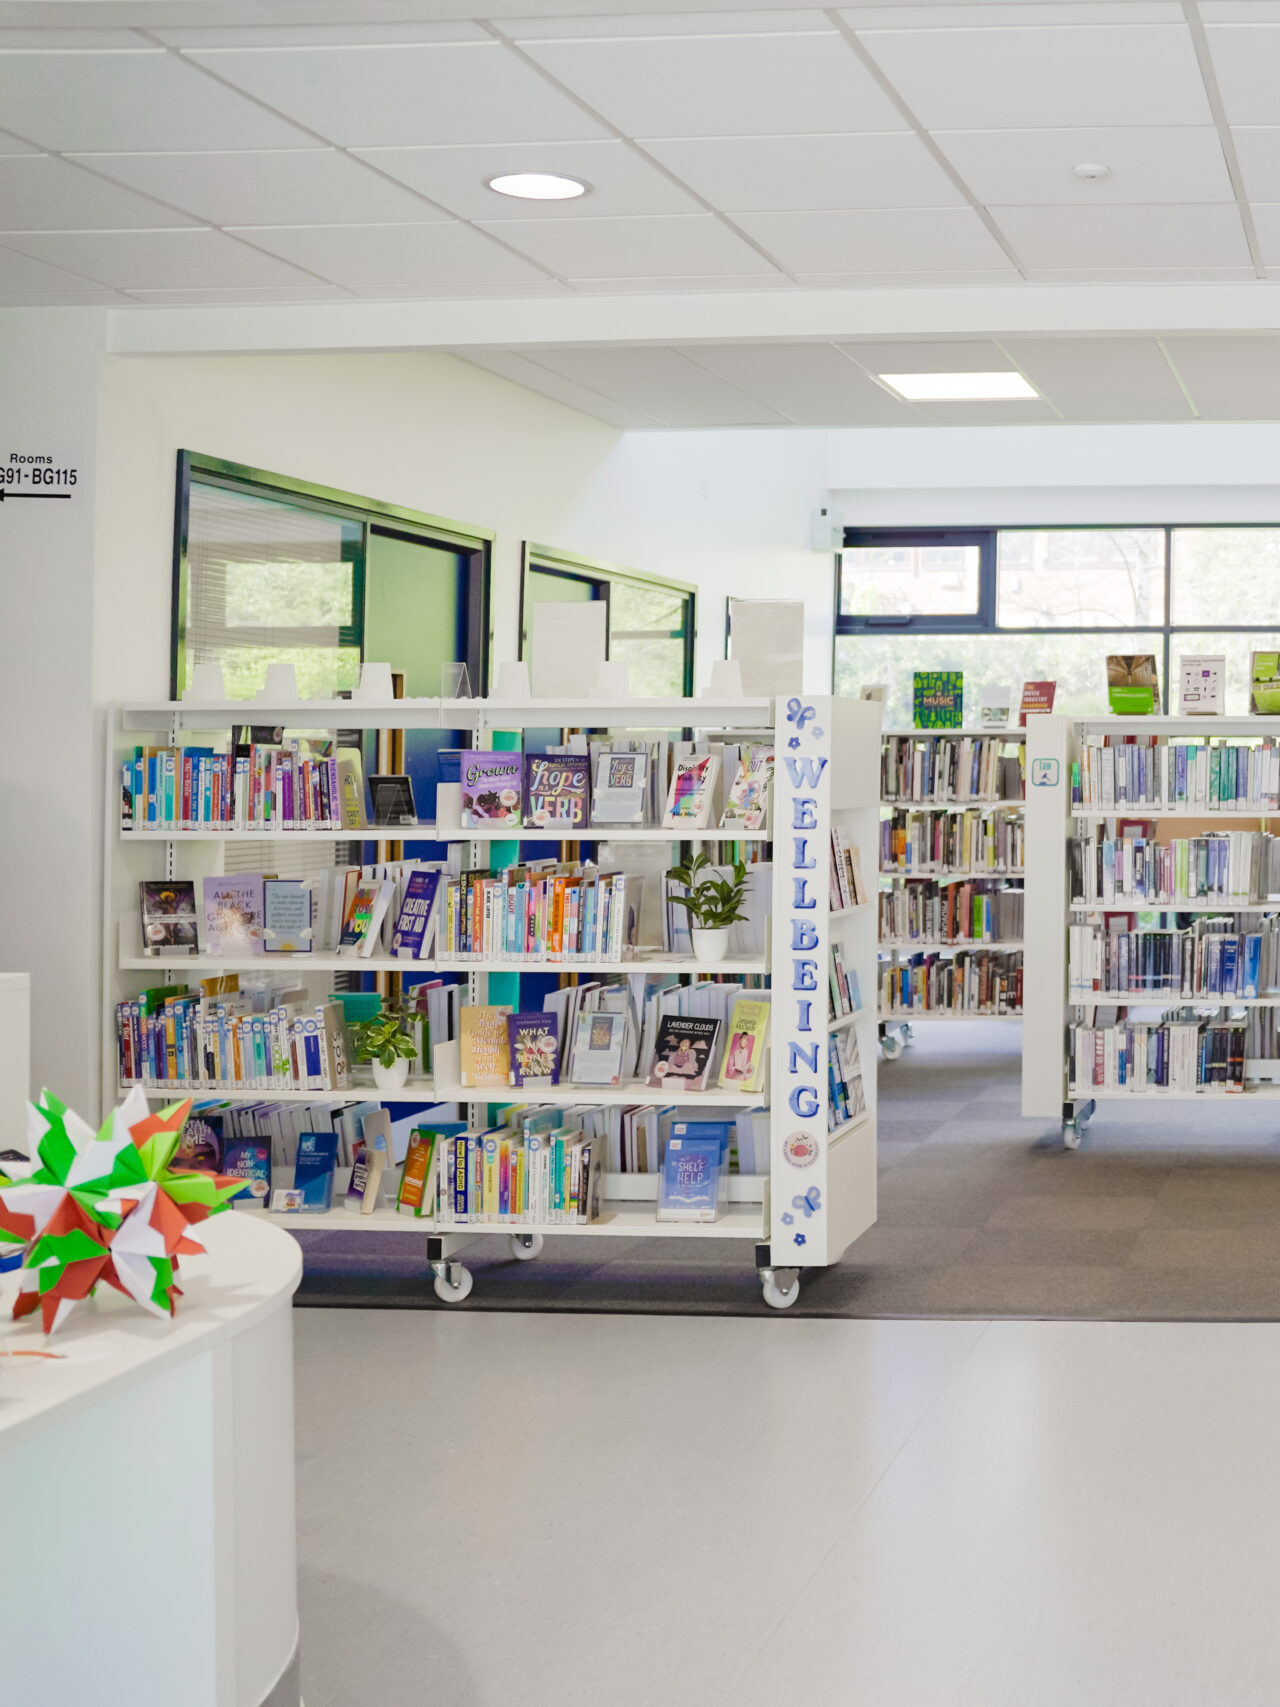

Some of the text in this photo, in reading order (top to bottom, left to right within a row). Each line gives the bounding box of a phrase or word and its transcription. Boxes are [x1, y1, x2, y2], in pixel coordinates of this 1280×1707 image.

[10, 453, 53, 464] Rooms
[923, 696, 954, 706] MUSIC
[467, 763, 518, 787] Grown
[530, 761, 586, 795] hope
[329, 758, 338, 804] FRIENDAHOLIC
[609, 774, 632, 788] VERB
[239, 890, 254, 898] THE
[217, 901, 252, 909] BLACK
[403, 898, 430, 916] CREATIVE
[397, 917, 425, 933] FIRST AID
[783, 757, 828, 1118] WELLBEING
[519, 1027, 549, 1036] WHAT
[667, 1020, 693, 1030] LAVENDER
[694, 1022, 714, 1032] CLOUDS
[518, 1053, 553, 1063] BONES
[519, 1067, 552, 1076] KNOW
[237, 1159, 256, 1169] NON-
[678, 1161, 704, 1172] SHELF
[227, 1168, 265, 1178] IDENTICAL
[677, 1173, 704, 1185] HELP
